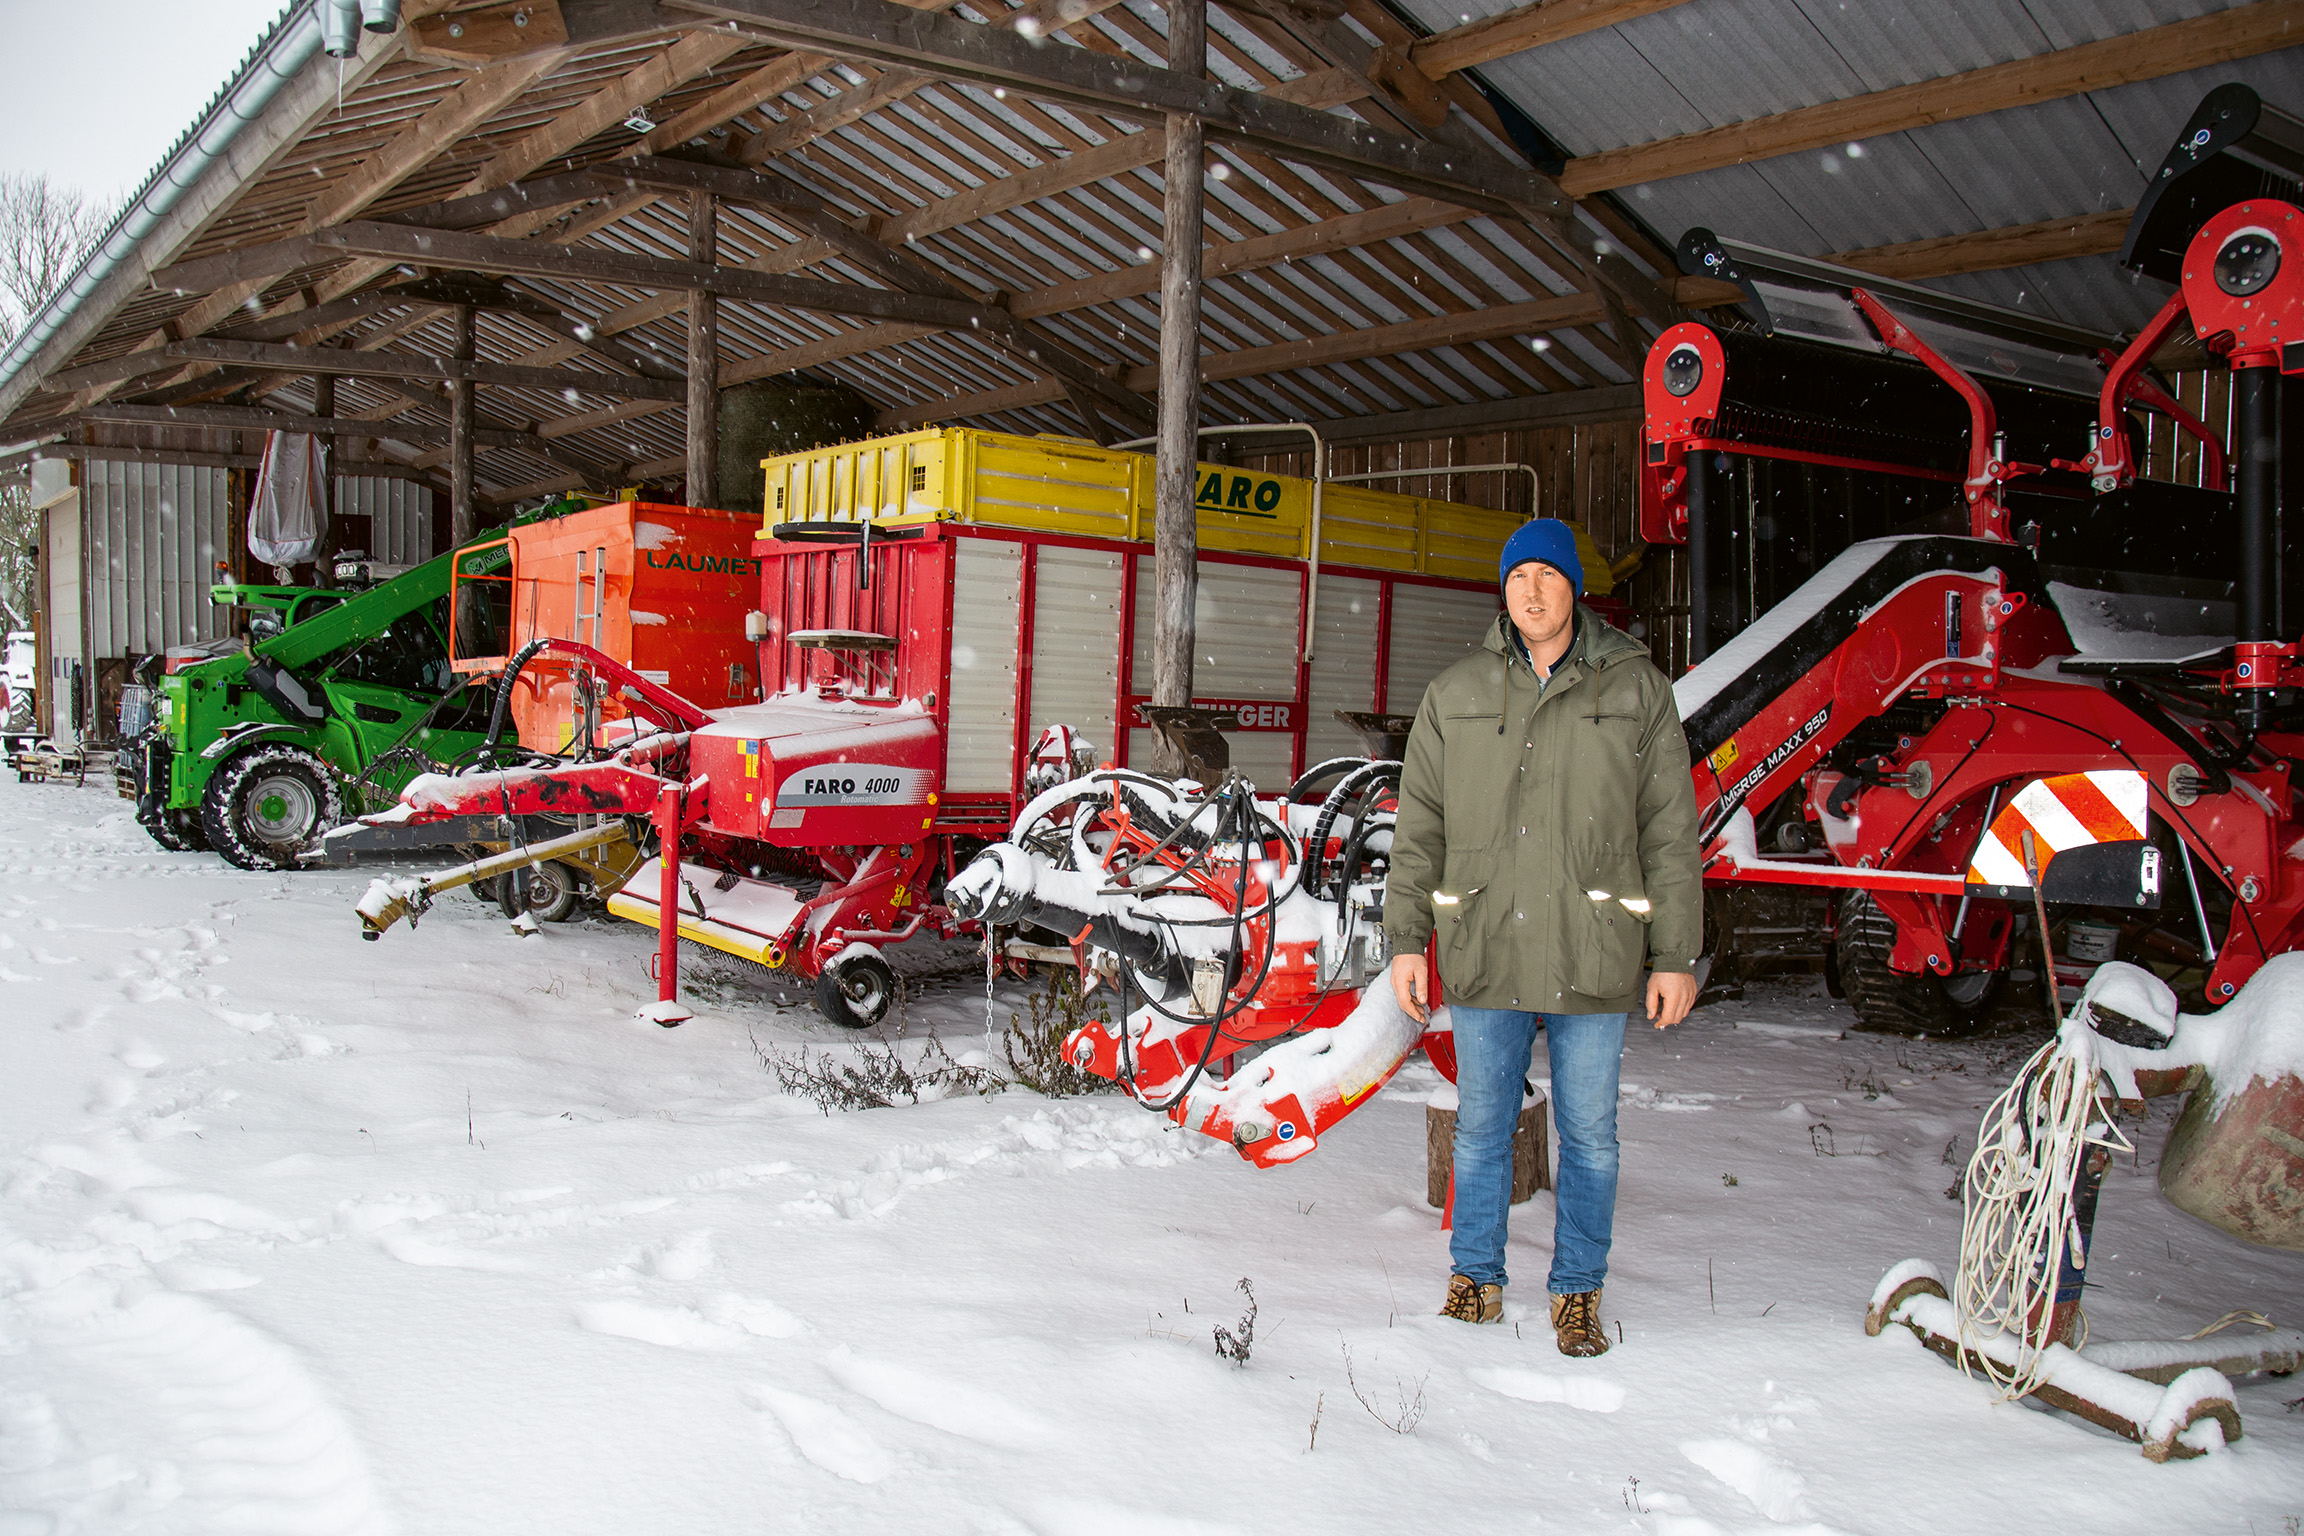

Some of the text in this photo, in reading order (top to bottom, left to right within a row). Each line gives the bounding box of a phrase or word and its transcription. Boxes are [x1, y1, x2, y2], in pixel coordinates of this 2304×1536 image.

[1766, 730, 1804, 769] MAXX
[1804, 709, 1828, 735] 950
[805, 778, 900, 794] FARO 4000
[840, 794, 879, 804] Rotomatic
